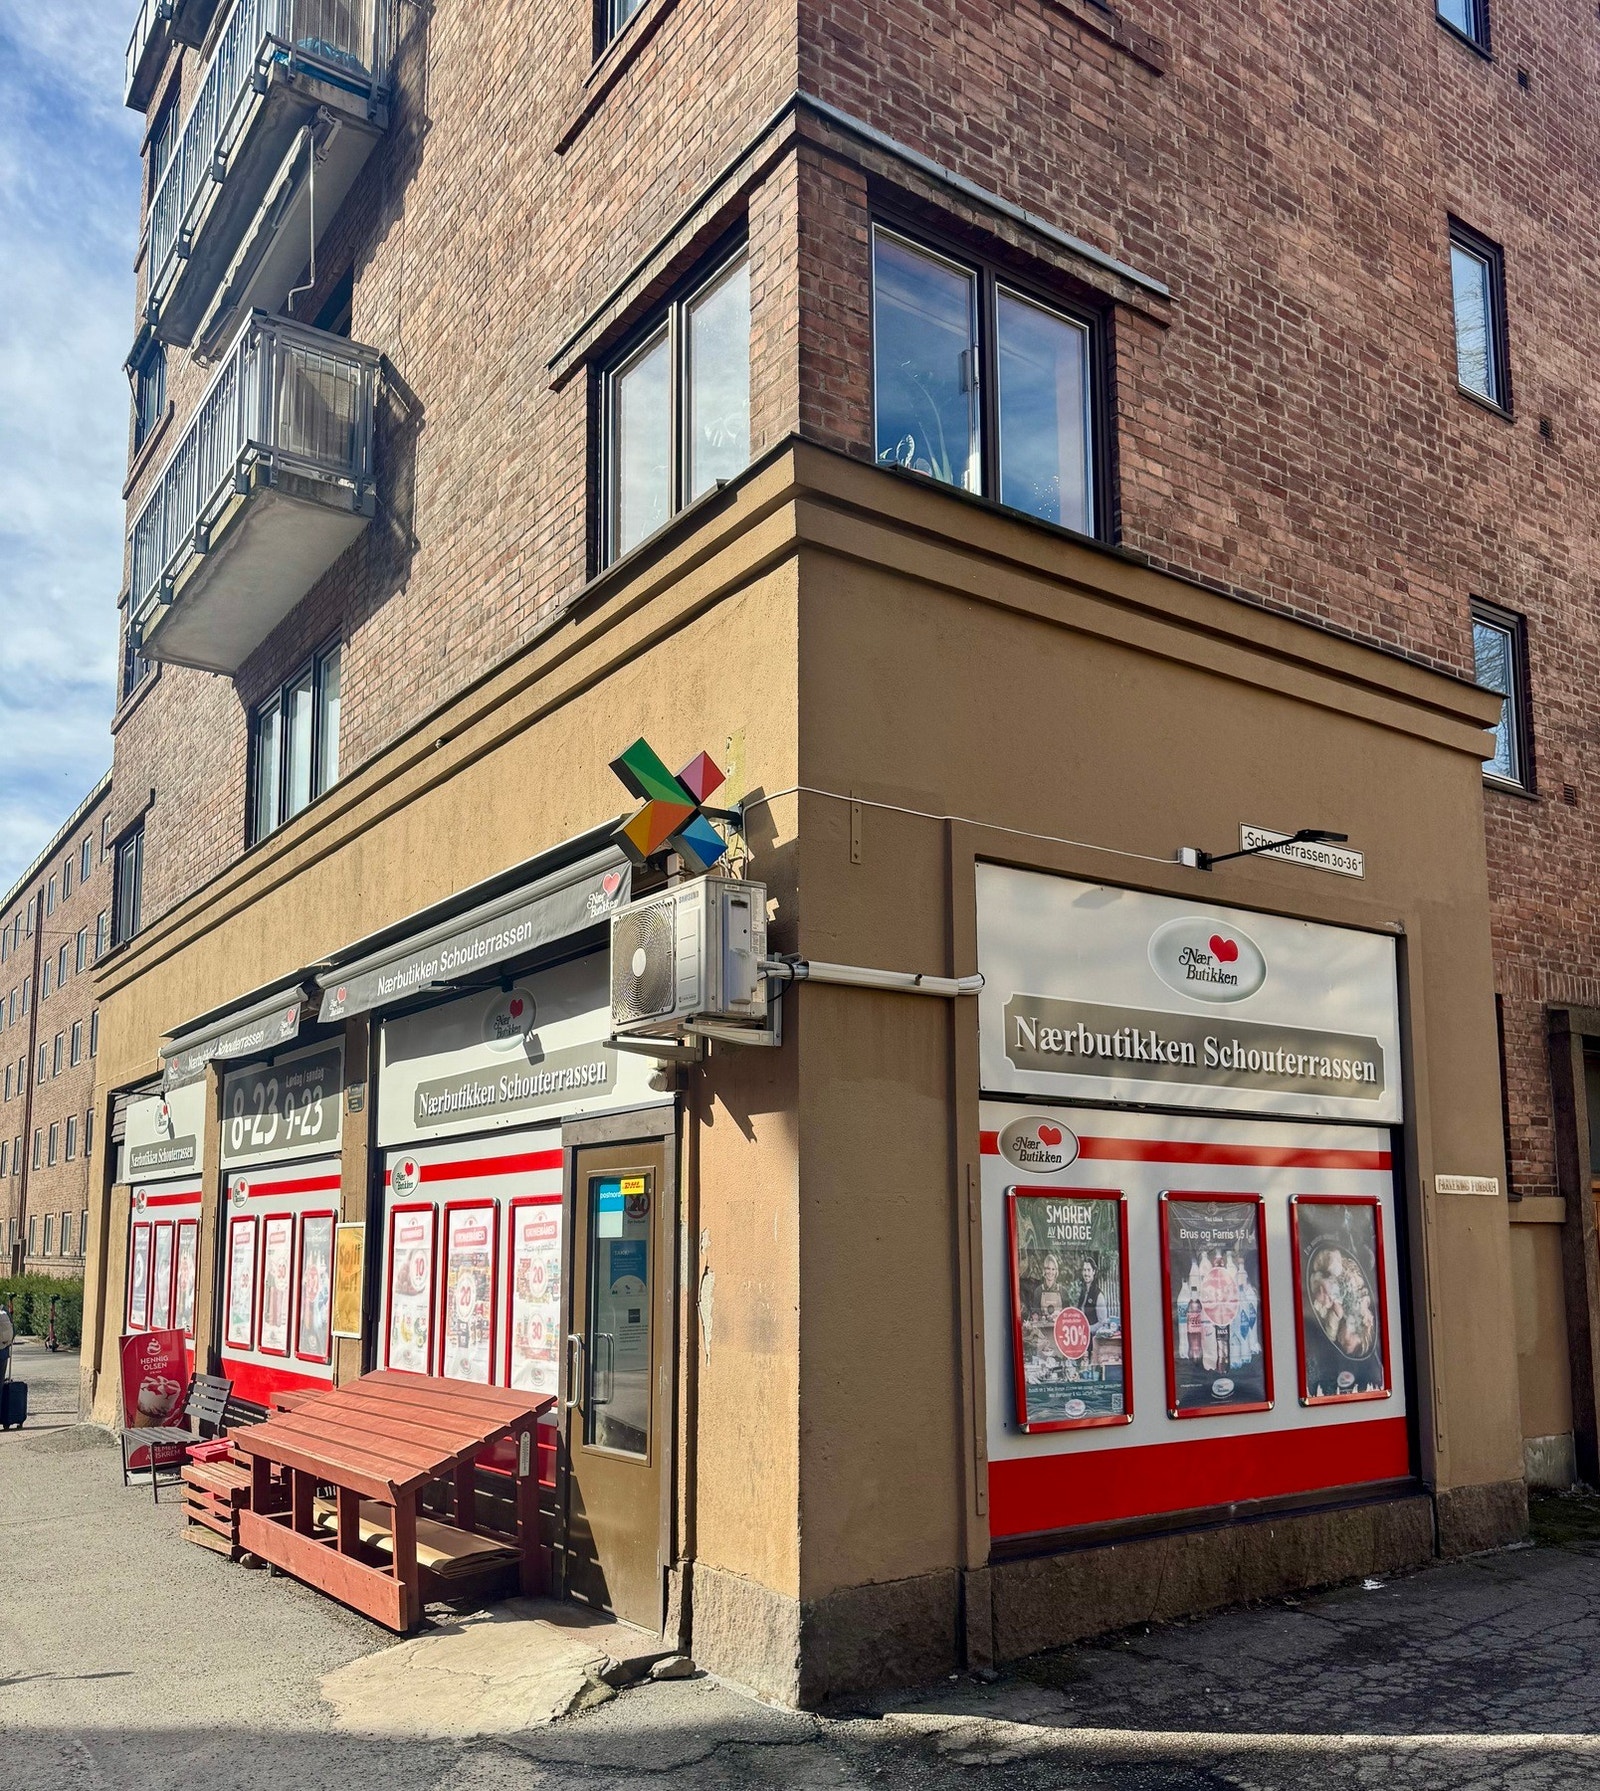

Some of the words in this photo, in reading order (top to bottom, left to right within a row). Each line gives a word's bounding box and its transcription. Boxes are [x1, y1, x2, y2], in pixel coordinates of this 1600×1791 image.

[1331, 853, 1358, 871] 30-36
[377, 959, 438, 996] Nærbutikken
[440, 921, 532, 971] Schouterrassen
[1178, 946, 1213, 965] Nær
[1186, 963, 1238, 985] Butikken
[1013, 1015, 1196, 1065] Nærbutikken
[1204, 1036, 1376, 1082] Schouterrassen
[419, 1082, 496, 1117] Nærbutikken
[499, 1060, 607, 1102] Schouterrassen
[231, 1078, 279, 1150] 8-23
[285, 1085, 323, 1140] 9-23
[1012, 1136, 1041, 1151] Nær
[1019, 1149, 1062, 1163] Butikken
[624, 1181, 641, 1189] DHL
[1046, 1205, 1092, 1224] SMAKEN
[1047, 1226, 1056, 1238] AV
[1057, 1225, 1092, 1240] NORGE
[1180, 1228, 1199, 1239] Brus
[1200, 1231, 1210, 1241] og
[1212, 1229, 1234, 1239] Farris
[416, 1258, 425, 1276] 10
[1059, 1324, 1088, 1346] -30%
[140, 1354, 169, 1365] HENNIG
[143, 1362, 167, 1371] OLSEN
